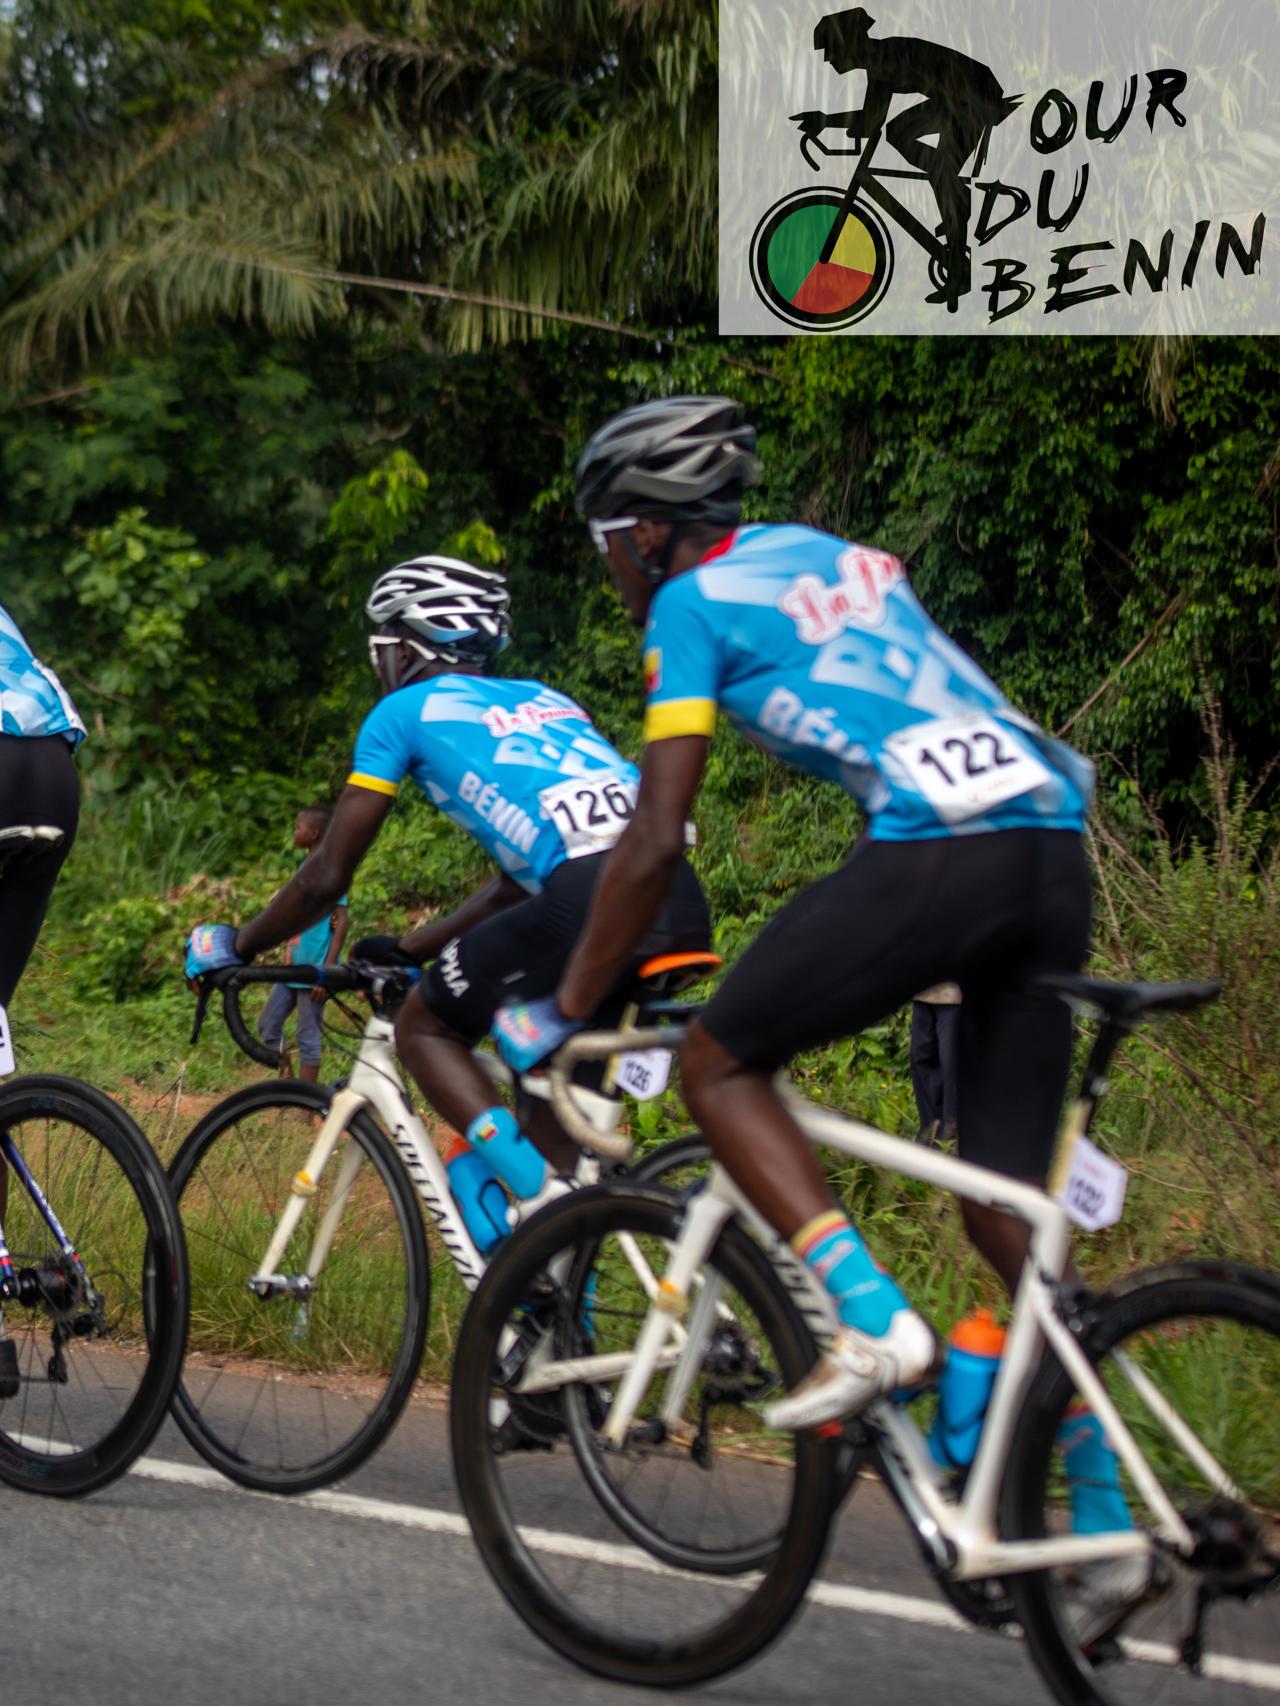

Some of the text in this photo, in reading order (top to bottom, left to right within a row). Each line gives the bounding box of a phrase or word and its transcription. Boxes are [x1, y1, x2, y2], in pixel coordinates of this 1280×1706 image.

[920, 732, 1018, 786] 122
[458, 770, 540, 855] BÉNIN
[553, 782, 636, 832] 126
